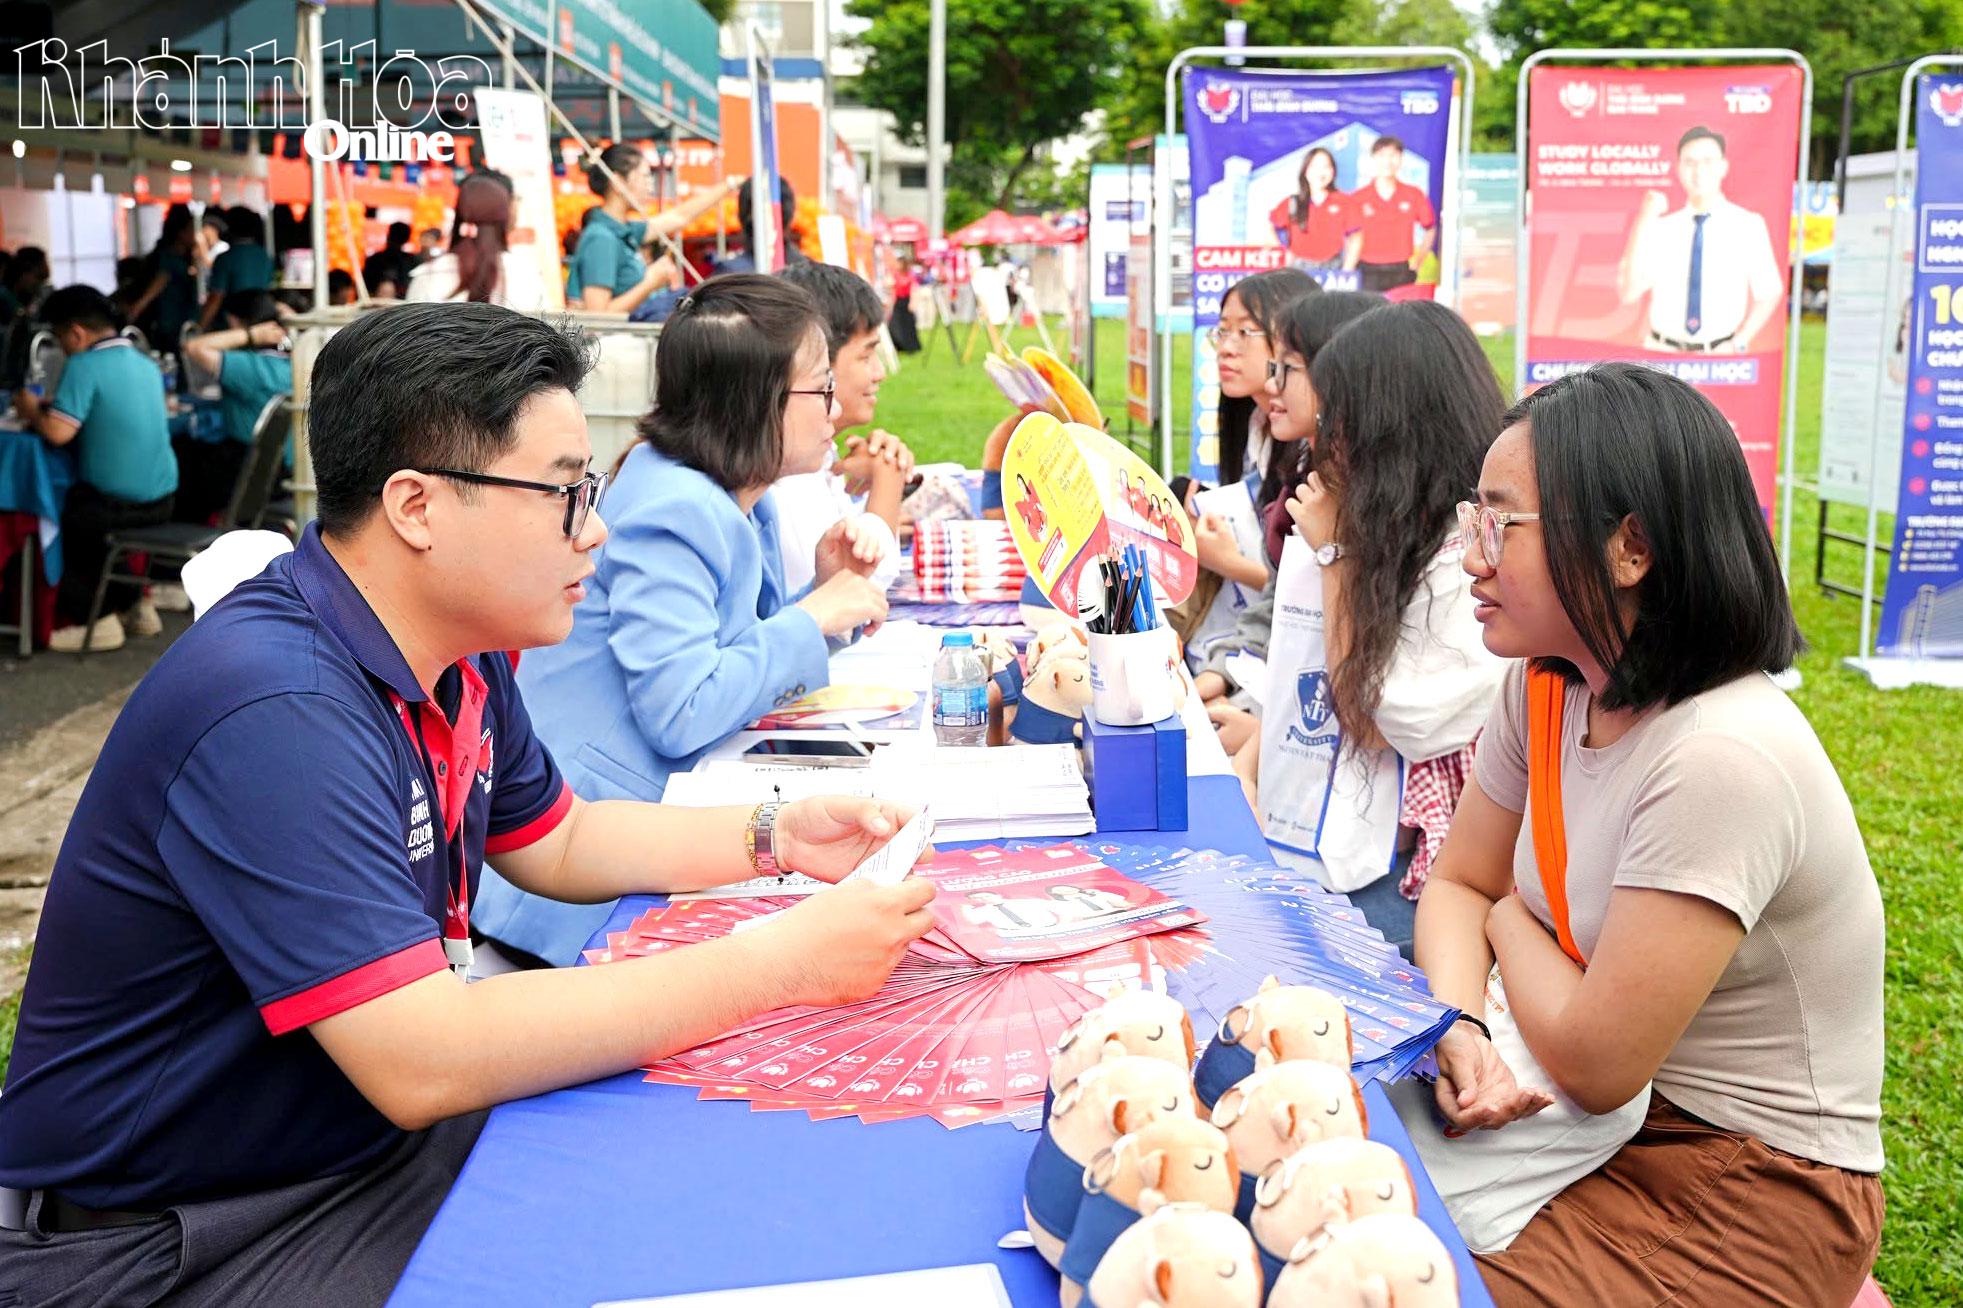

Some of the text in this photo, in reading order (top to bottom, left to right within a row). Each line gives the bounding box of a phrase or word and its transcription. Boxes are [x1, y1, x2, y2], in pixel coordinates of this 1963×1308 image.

[1724, 93, 1773, 114] TBD
[1538, 144, 1661, 160] STUDY LOCALLY
[1538, 160, 1672, 177] WORK GLOBALLY
[1197, 250, 1242, 269] CAM
